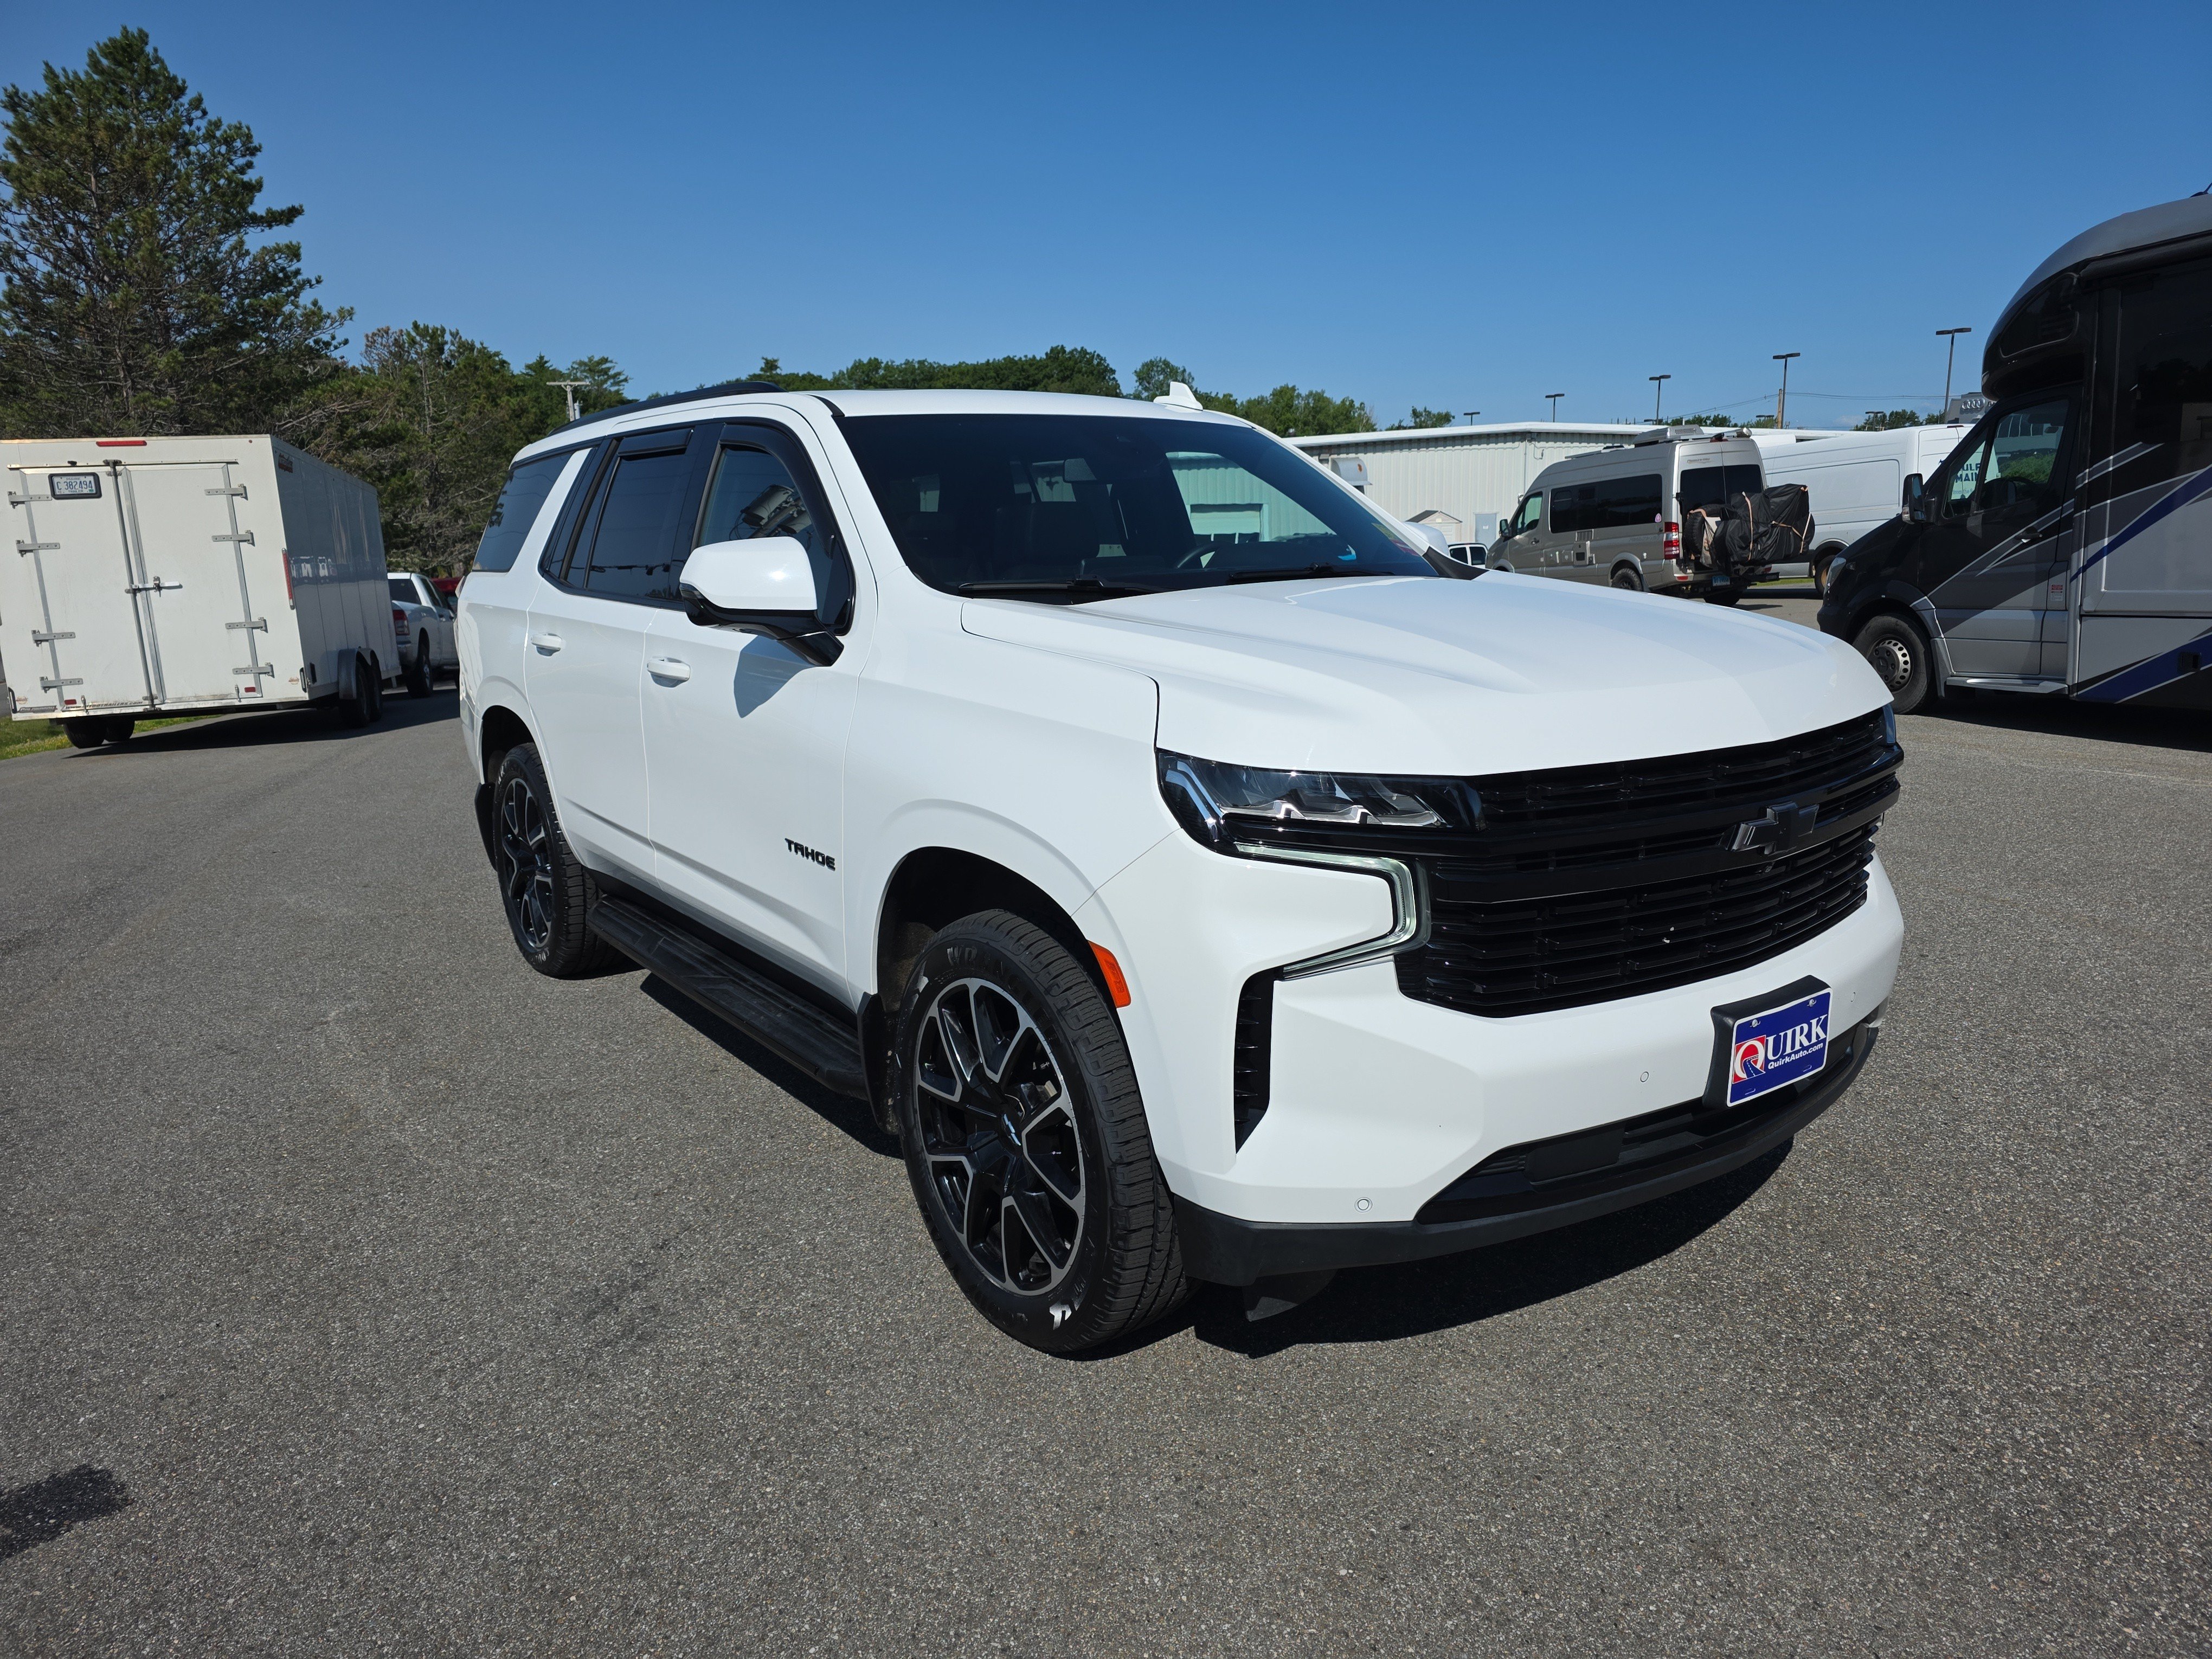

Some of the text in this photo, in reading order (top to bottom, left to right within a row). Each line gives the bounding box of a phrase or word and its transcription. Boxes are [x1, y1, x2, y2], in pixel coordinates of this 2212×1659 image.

[1955, 472, 1986, 483] MAIN
[1962, 463, 1980, 471] ULF
[785, 838, 835, 871] TAHOE
[1734, 1014, 1828, 1079] QUIRK
[1767, 1042, 1823, 1070] QuirkAuto.com
